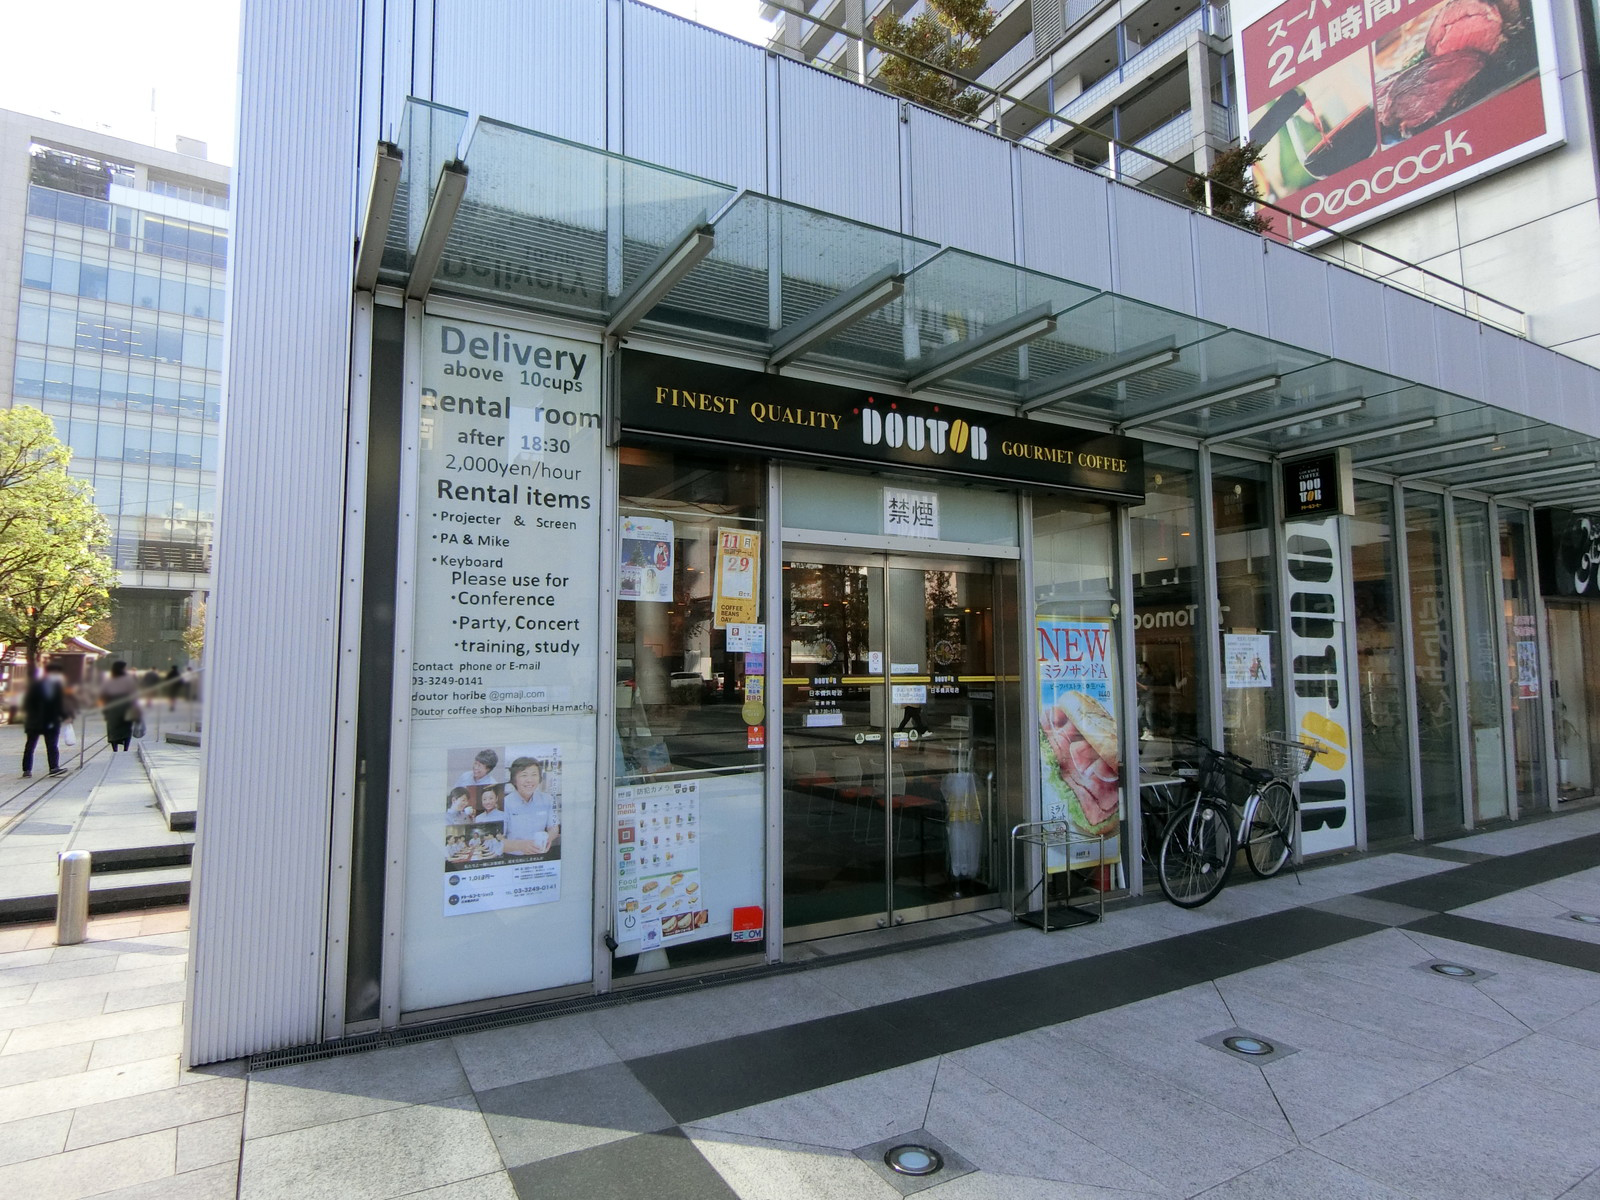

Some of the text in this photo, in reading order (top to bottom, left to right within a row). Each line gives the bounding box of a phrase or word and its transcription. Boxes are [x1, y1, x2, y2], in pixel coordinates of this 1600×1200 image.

[1267, 0, 1419, 88] 24時間
[441, 325, 587, 380] Delivery
[443, 360, 583, 395] above 10cups
[421, 387, 601, 433] Rental room
[655, 386, 842, 430] FINEST QUALITY
[458, 428, 571, 454] after 18:30
[862, 407, 1128, 473] DOUTOR GOURMET COFFEE
[446, 454, 582, 481] 2,000yen/hour
[1299, 478, 1321, 492] DOU
[438, 478, 591, 510] Rental items
[441, 511, 577, 530] Projecter & Screen
[888, 498, 934, 527] 禁煙
[440, 533, 510, 547] PA & Mike
[440, 555, 503, 570] Keyboard
[452, 571, 569, 588] Please use for
[458, 591, 555, 607] Conference
[720, 604, 743, 612] COFFEE
[459, 616, 580, 633] Party, Concert
[461, 639, 580, 657] training, study
[1037, 628, 1110, 662] NEW
[412, 661, 541, 672] Contact phone or E-mail
[1043, 663, 1108, 680] ミラノサンドA
[411, 676, 483, 686] 03-3249-0141
[1286, 518, 1348, 833] OUTOR
[411, 689, 545, 702] doutor horibe @gmail.com
[447, 706, 478, 716] coffee
[480, 705, 503, 716] shop
[505, 703, 550, 714] Nihonbasi
[552, 702, 594, 712] Hamacho
[617, 802, 636, 811] Drink
[617, 808, 637, 816] menu
[618, 878, 637, 886] Food
